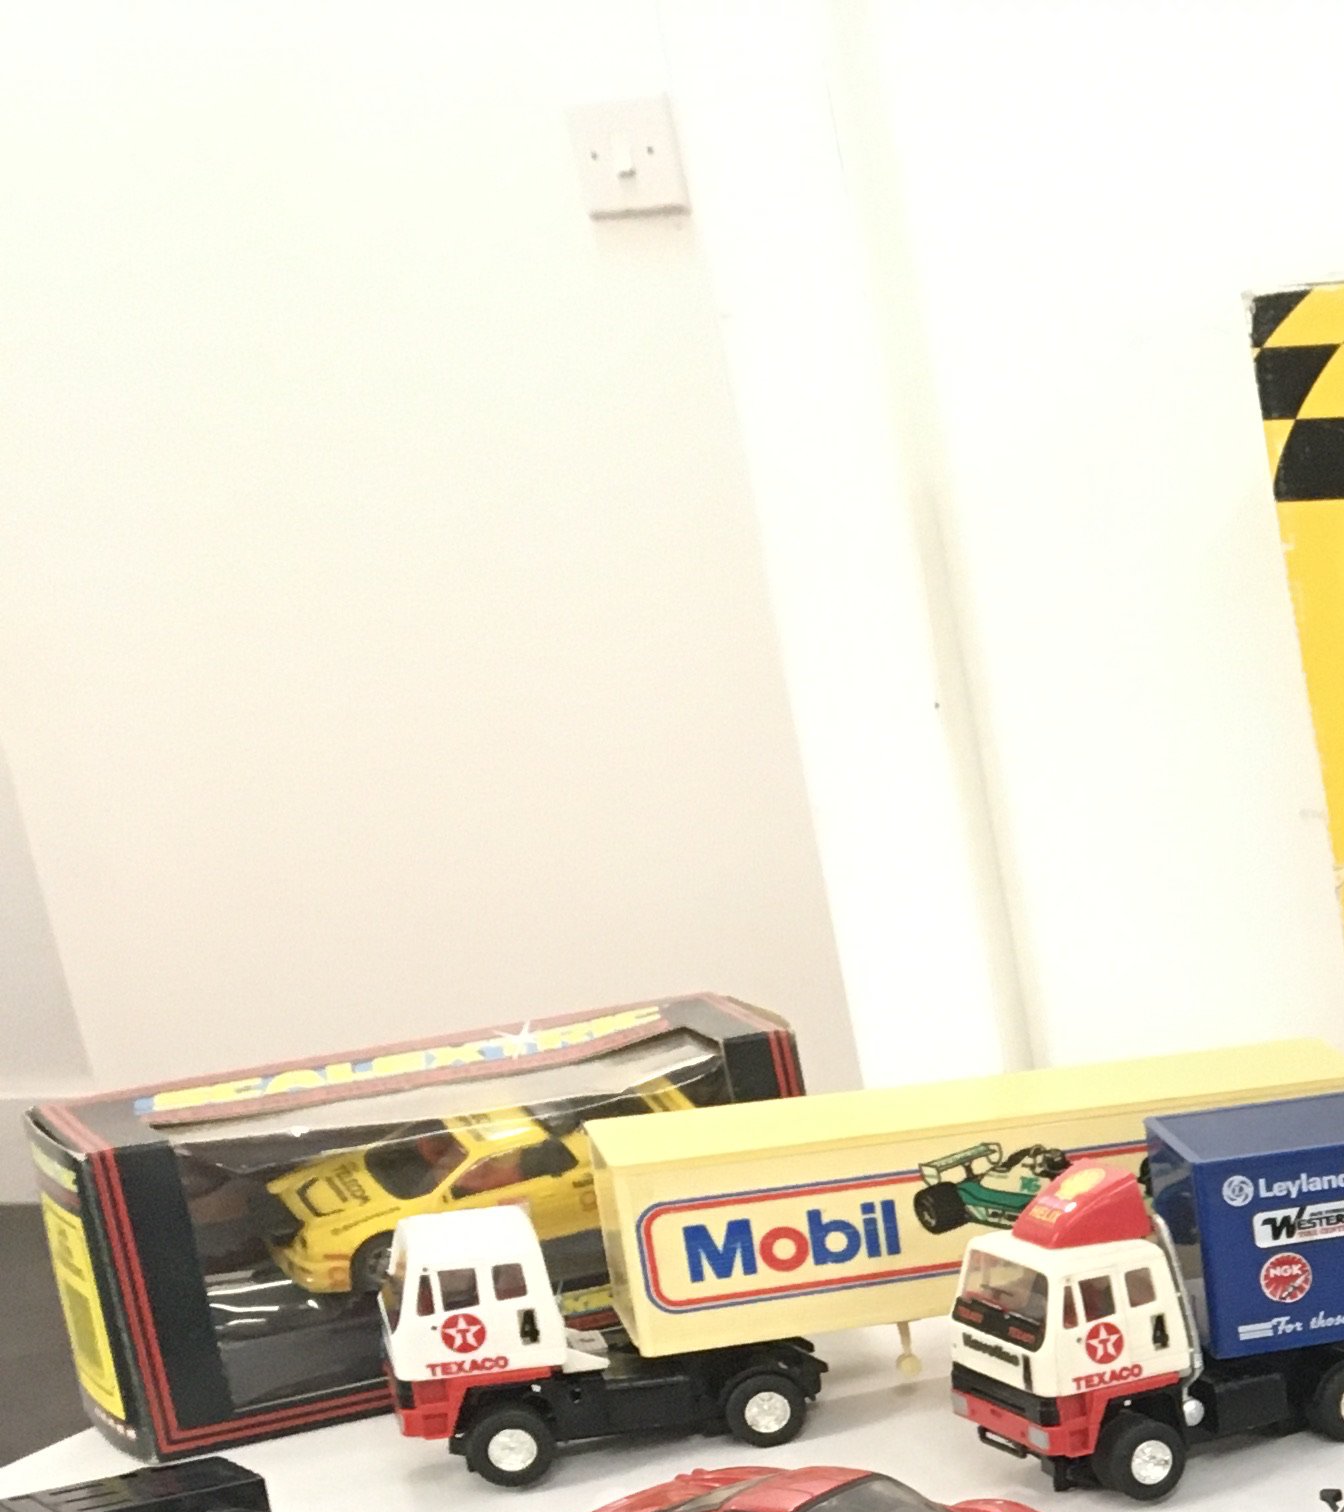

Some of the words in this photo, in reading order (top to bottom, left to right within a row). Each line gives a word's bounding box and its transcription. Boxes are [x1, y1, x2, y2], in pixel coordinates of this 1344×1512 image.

[682, 1200, 901, 1284] Mobil
[1269, 1263, 1302, 1278] NGK
[1274, 1315, 1303, 1335] For
[426, 1356, 509, 1377] TEXACO
[1072, 1364, 1143, 1390] TEXACO
